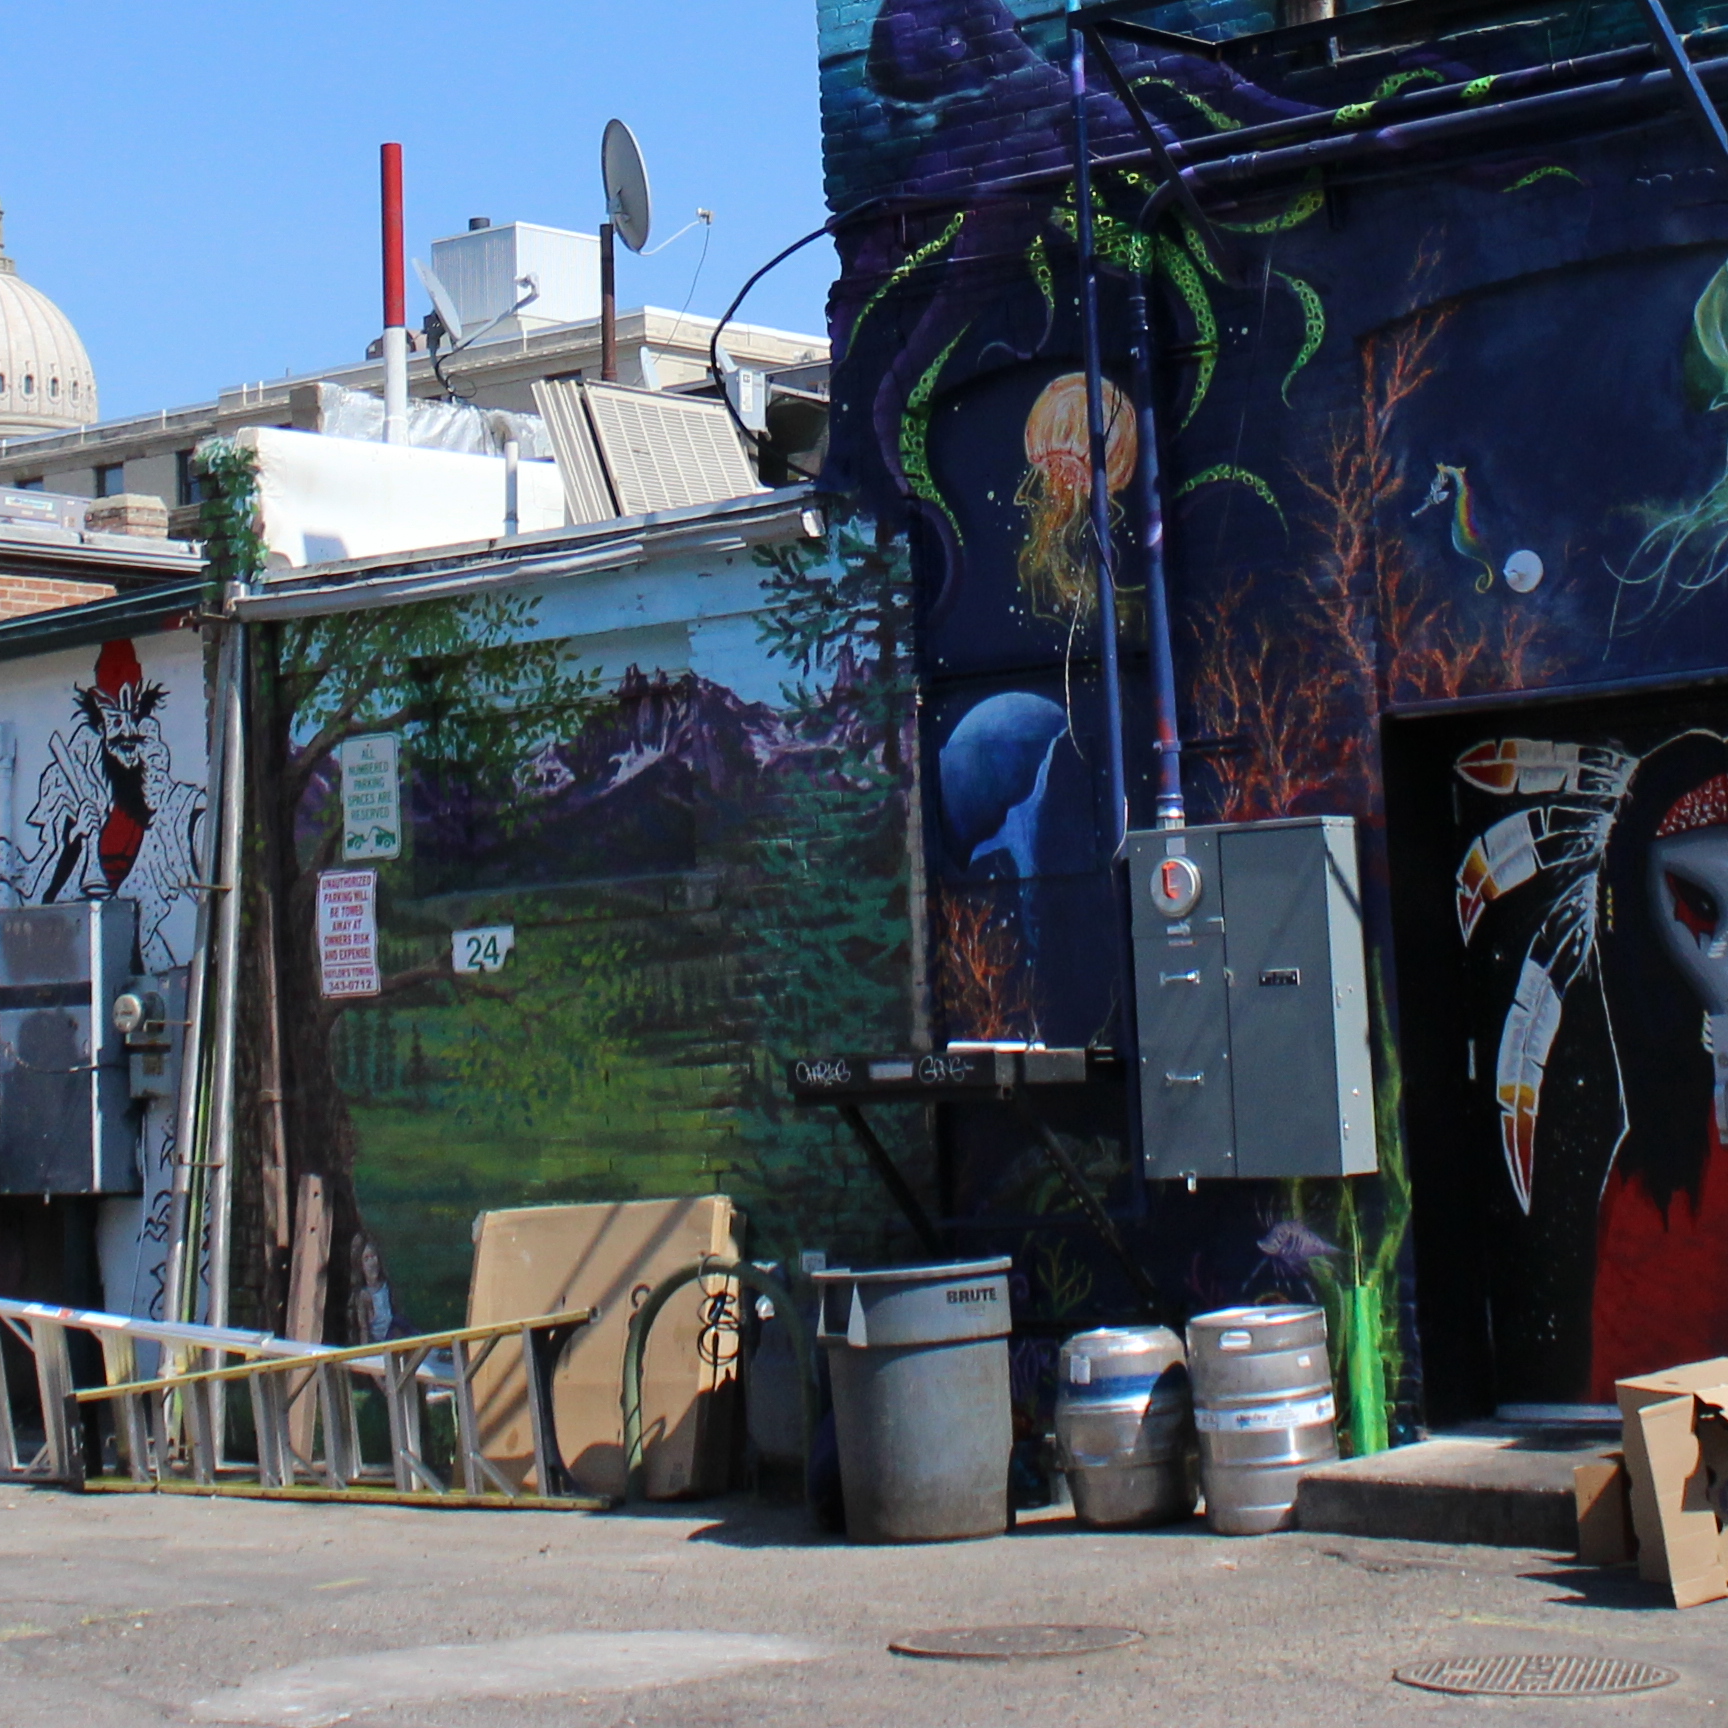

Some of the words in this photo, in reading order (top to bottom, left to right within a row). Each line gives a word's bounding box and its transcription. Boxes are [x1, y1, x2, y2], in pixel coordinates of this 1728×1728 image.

[322, 876, 371, 890] UNAUTHORIZED
[323, 891, 352, 904] PARKING
[354, 889, 369, 901] WILL
[329, 906, 339, 918] BE
[342, 904, 364, 917] TOWED
[332, 920, 352, 931] AWAY
[353, 918, 362, 929] AT
[324, 934, 352, 947] OWNERS
[354, 932, 370, 945] RISK
[324, 949, 338, 961] AND
[467, 935, 500, 968] 24
[328, 979, 372, 992] 343-0712
[946, 1287, 998, 1304] BRUTE
